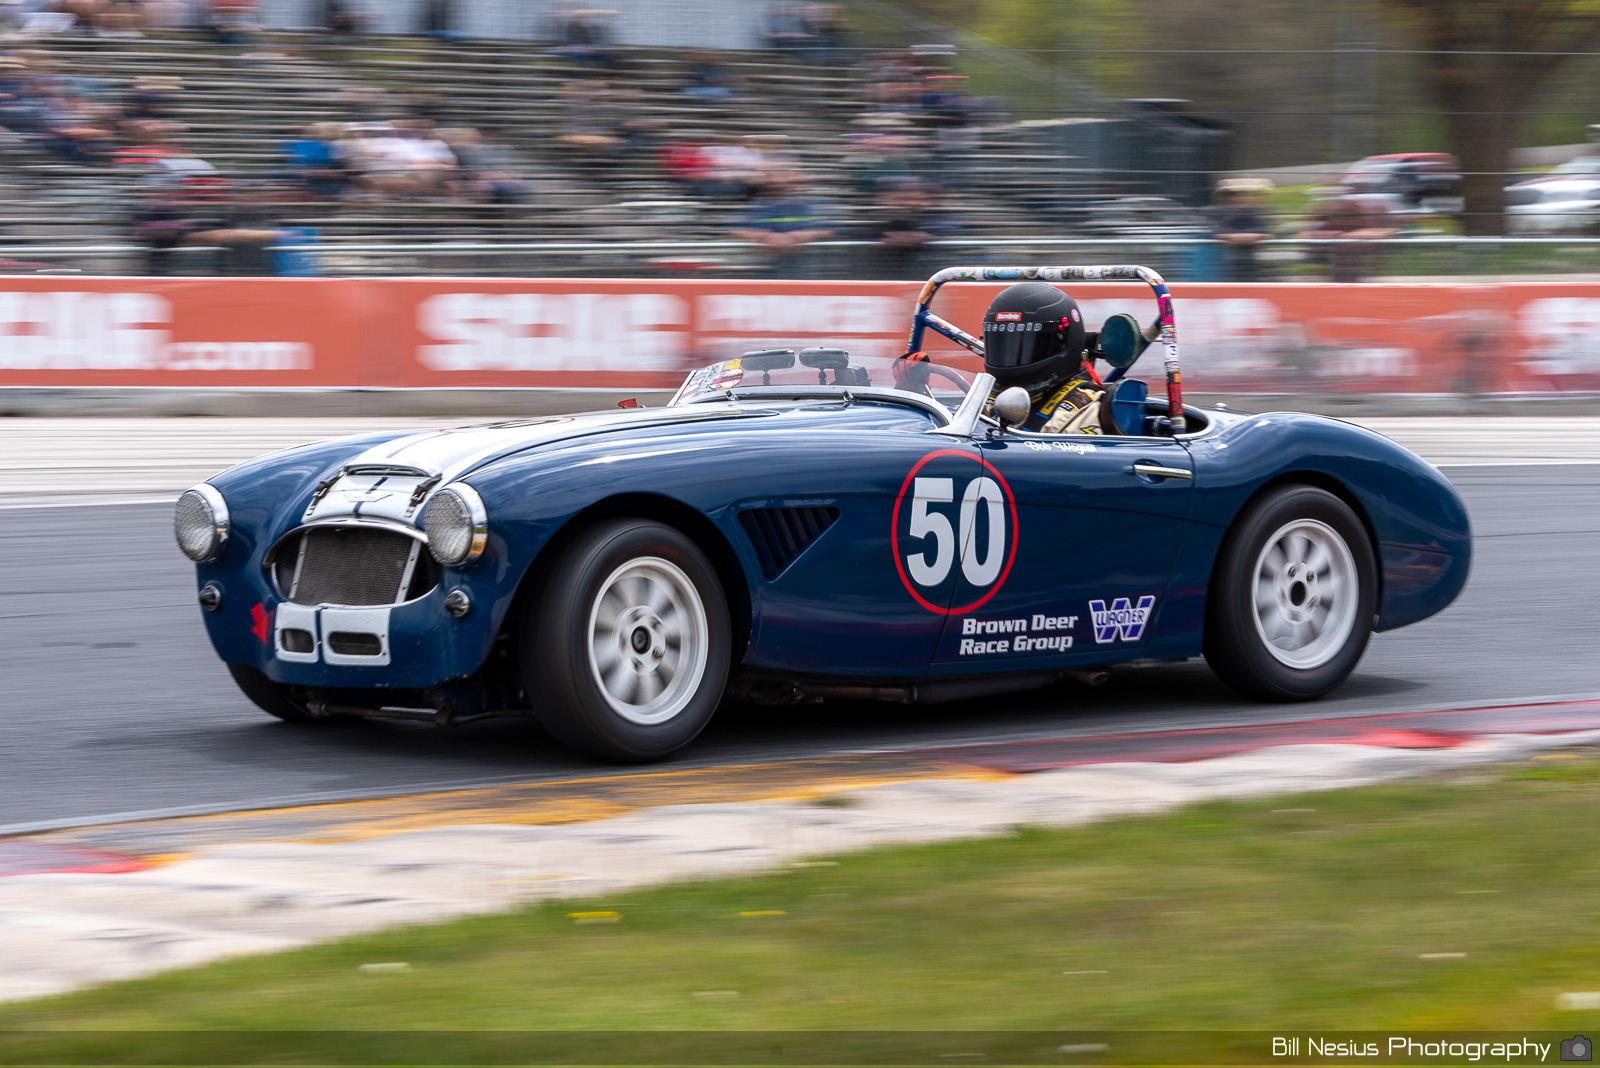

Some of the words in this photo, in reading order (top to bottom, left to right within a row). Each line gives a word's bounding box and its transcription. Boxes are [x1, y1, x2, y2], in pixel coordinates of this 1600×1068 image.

[1024, 441, 1052, 451] Bob
[906, 476, 1006, 587] 50
[962, 618, 1028, 636] Brown
[1031, 613, 1079, 632] Deer
[1095, 609, 1146, 627] WAGNER
[959, 638, 1010, 657] Race
[1013, 635, 1074, 653] Group
